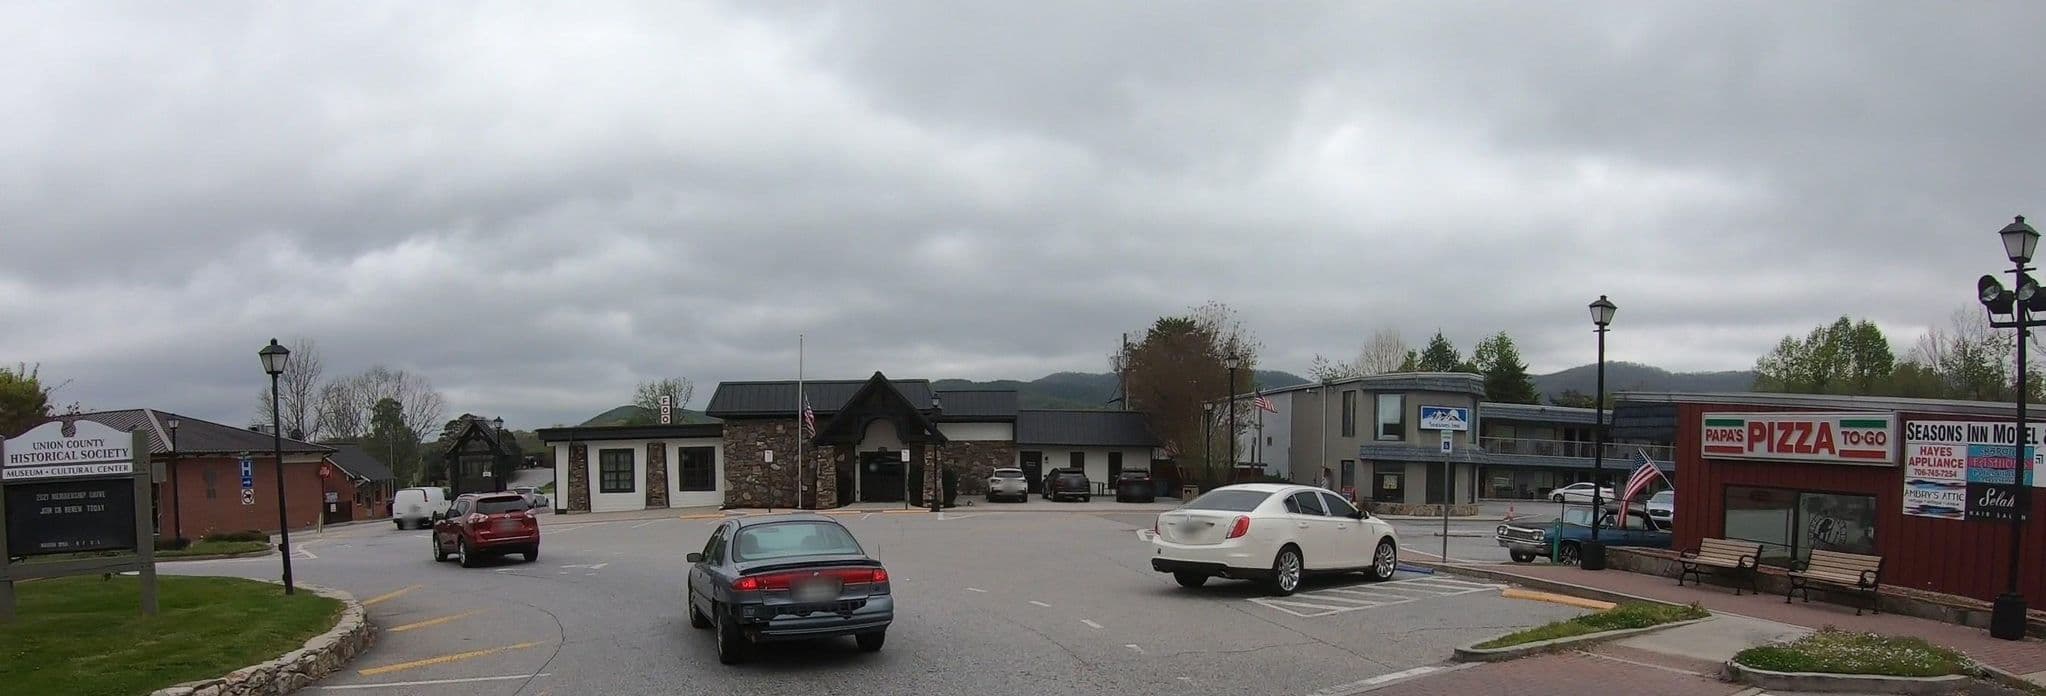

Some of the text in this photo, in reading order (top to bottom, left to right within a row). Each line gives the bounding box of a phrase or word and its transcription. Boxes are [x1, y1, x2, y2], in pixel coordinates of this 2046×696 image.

[1705, 429, 1744, 442] PAPA'S
[1747, 421, 1836, 455] PIZZA
[1907, 422, 1963, 442] SEASONS
[1967, 423, 1988, 443] INN
[1993, 424, 2039, 445] MOEL
[32, 438, 105, 451] UNION COUNTY
[10, 448, 129, 464] HISTORICAL SOCIETY
[1920, 446, 1952, 457] HAYES
[241, 460, 253, 476] H
[1908, 457, 1964, 469] APPLIANCE
[6, 464, 129, 477] MUSEUM CULTURAL CENTER
[1942, 491, 1964, 502] ATTIC
[1979, 487, 2016, 508] Selah
[87, 504, 105, 512] TODAY
[1997, 512, 2026, 520] SALN
